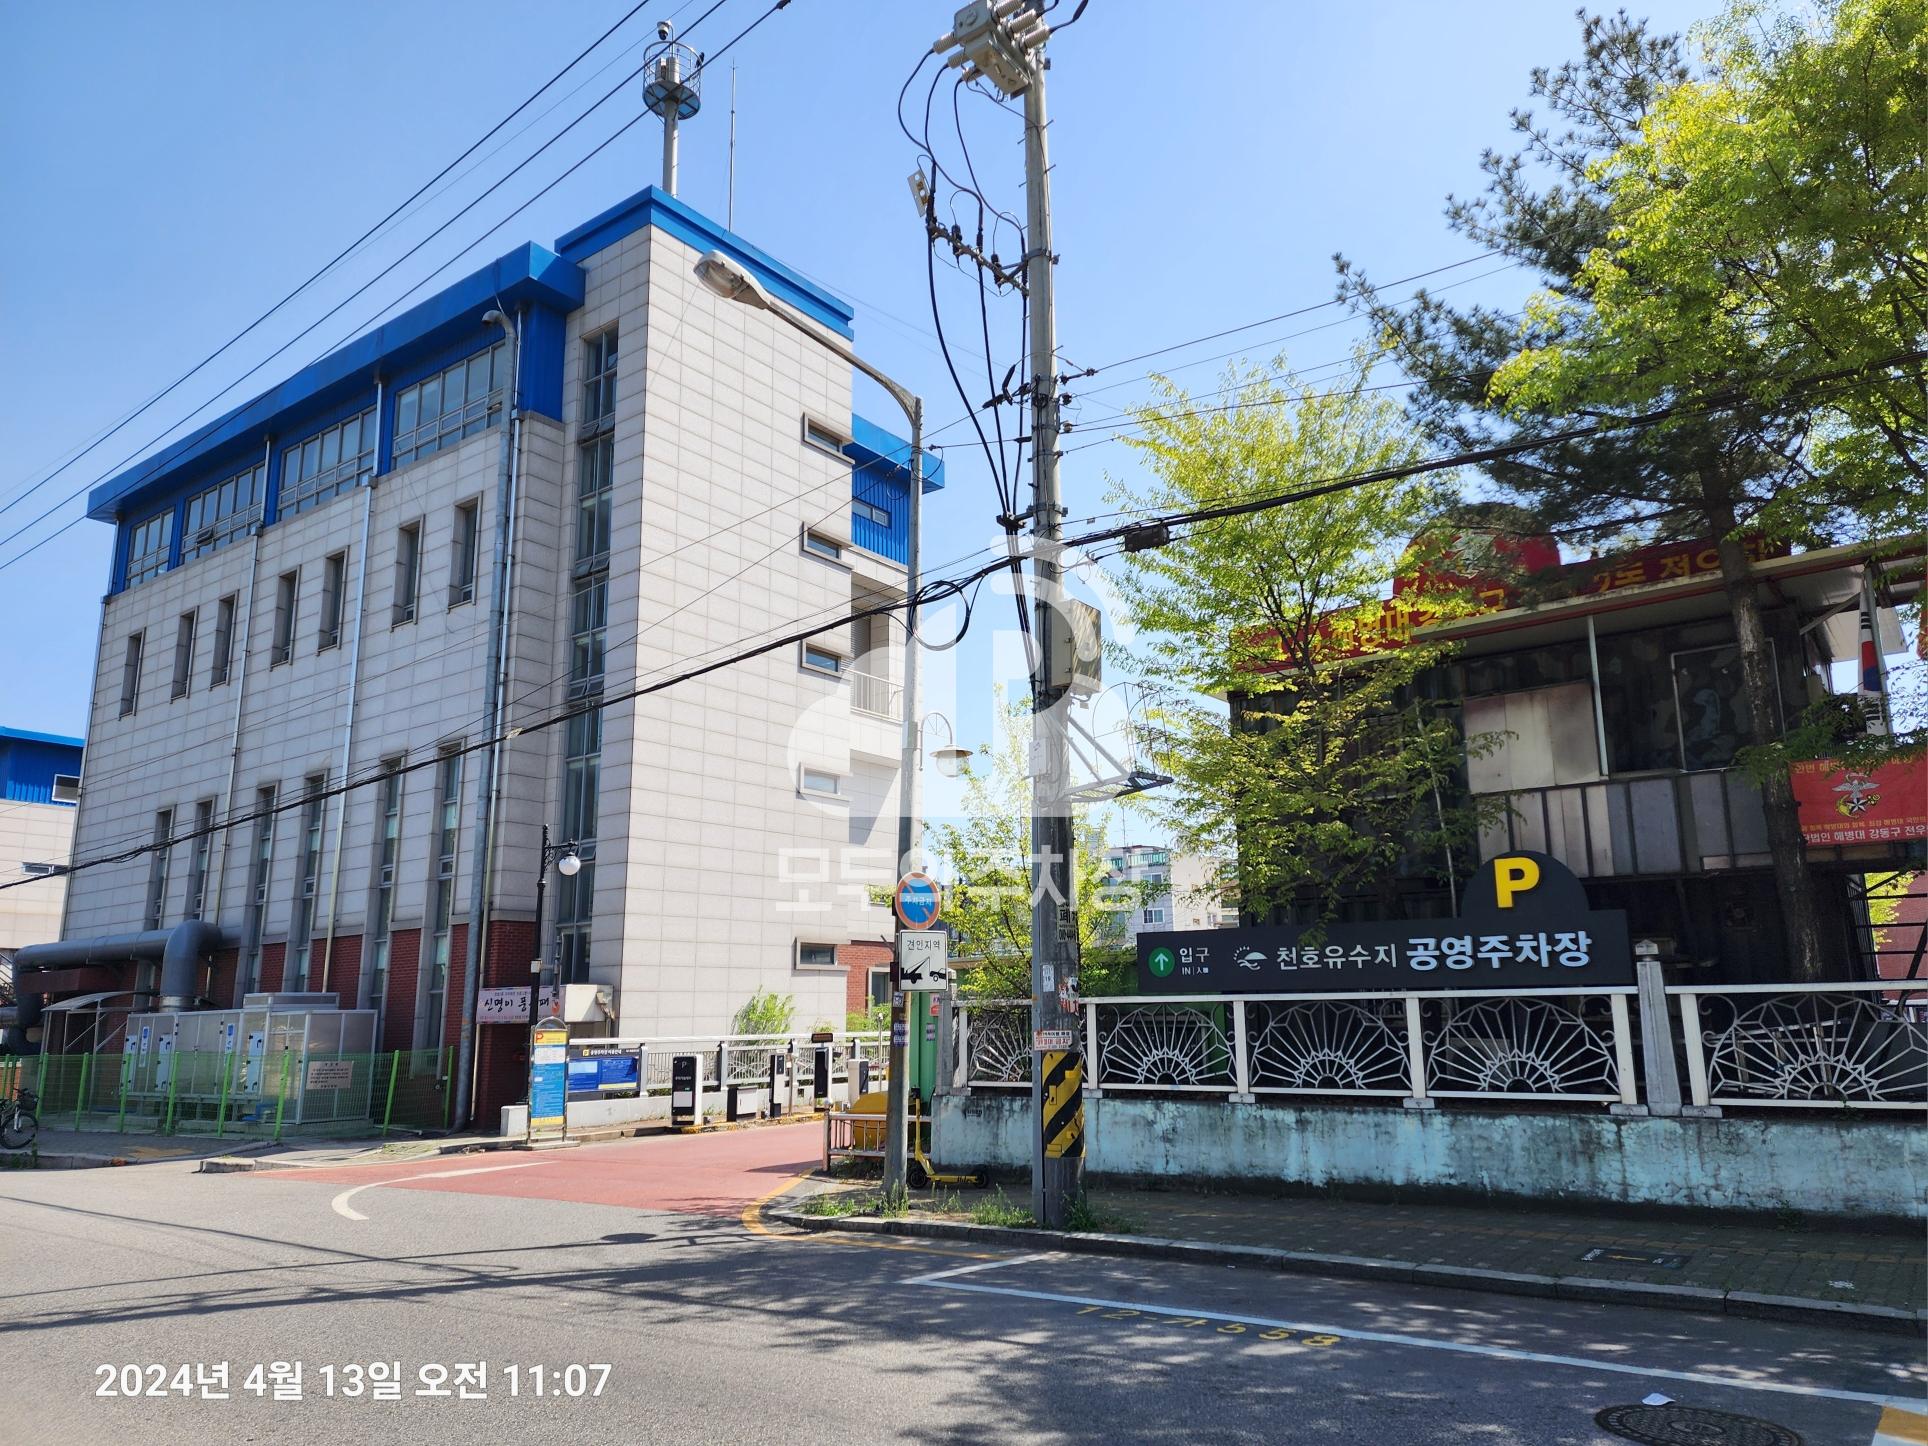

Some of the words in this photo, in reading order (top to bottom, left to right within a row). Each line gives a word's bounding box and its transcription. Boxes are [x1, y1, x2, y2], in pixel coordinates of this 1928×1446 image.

[1834, 830, 1866, 841] 해병대
[1869, 826, 1901, 839] 강동구
[1493, 856, 1541, 909] P
[904, 895, 932, 906] 주차금지
[906, 939, 940, 951] 견인지역
[1276, 943, 1398, 971] 천호유수지
[1405, 929, 1593, 972] 공영주차장
[1179, 946, 1210, 964] 입구
[1181, 966, 1191, 976] IN
[518, 996, 549, 1013] 풍패
